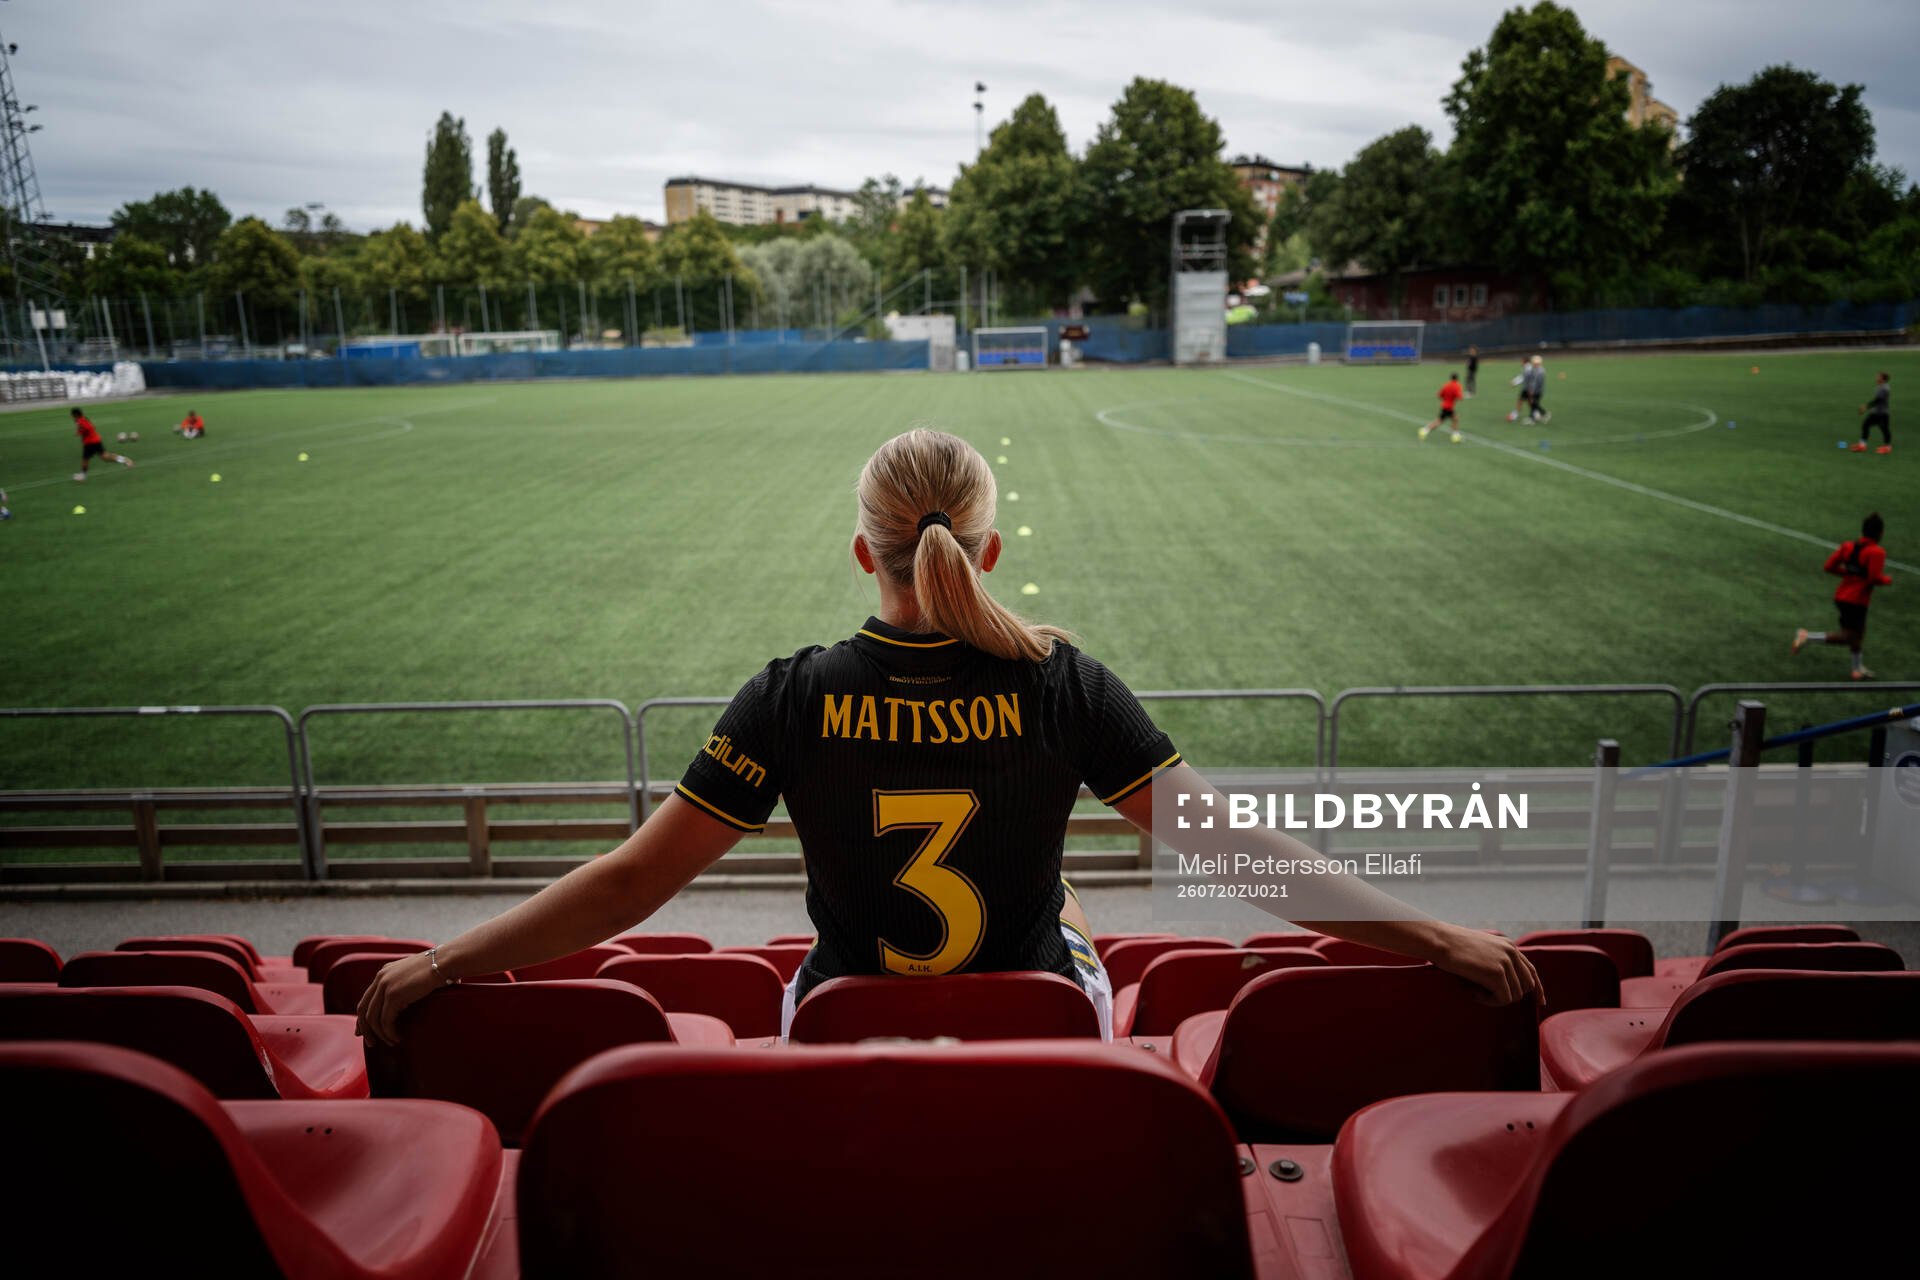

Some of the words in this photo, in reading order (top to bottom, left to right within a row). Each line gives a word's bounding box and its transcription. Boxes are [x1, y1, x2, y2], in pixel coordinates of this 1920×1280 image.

[822, 693, 1023, 744] MATTSSON
[703, 734, 766, 787] dium
[872, 788, 988, 976] 3
